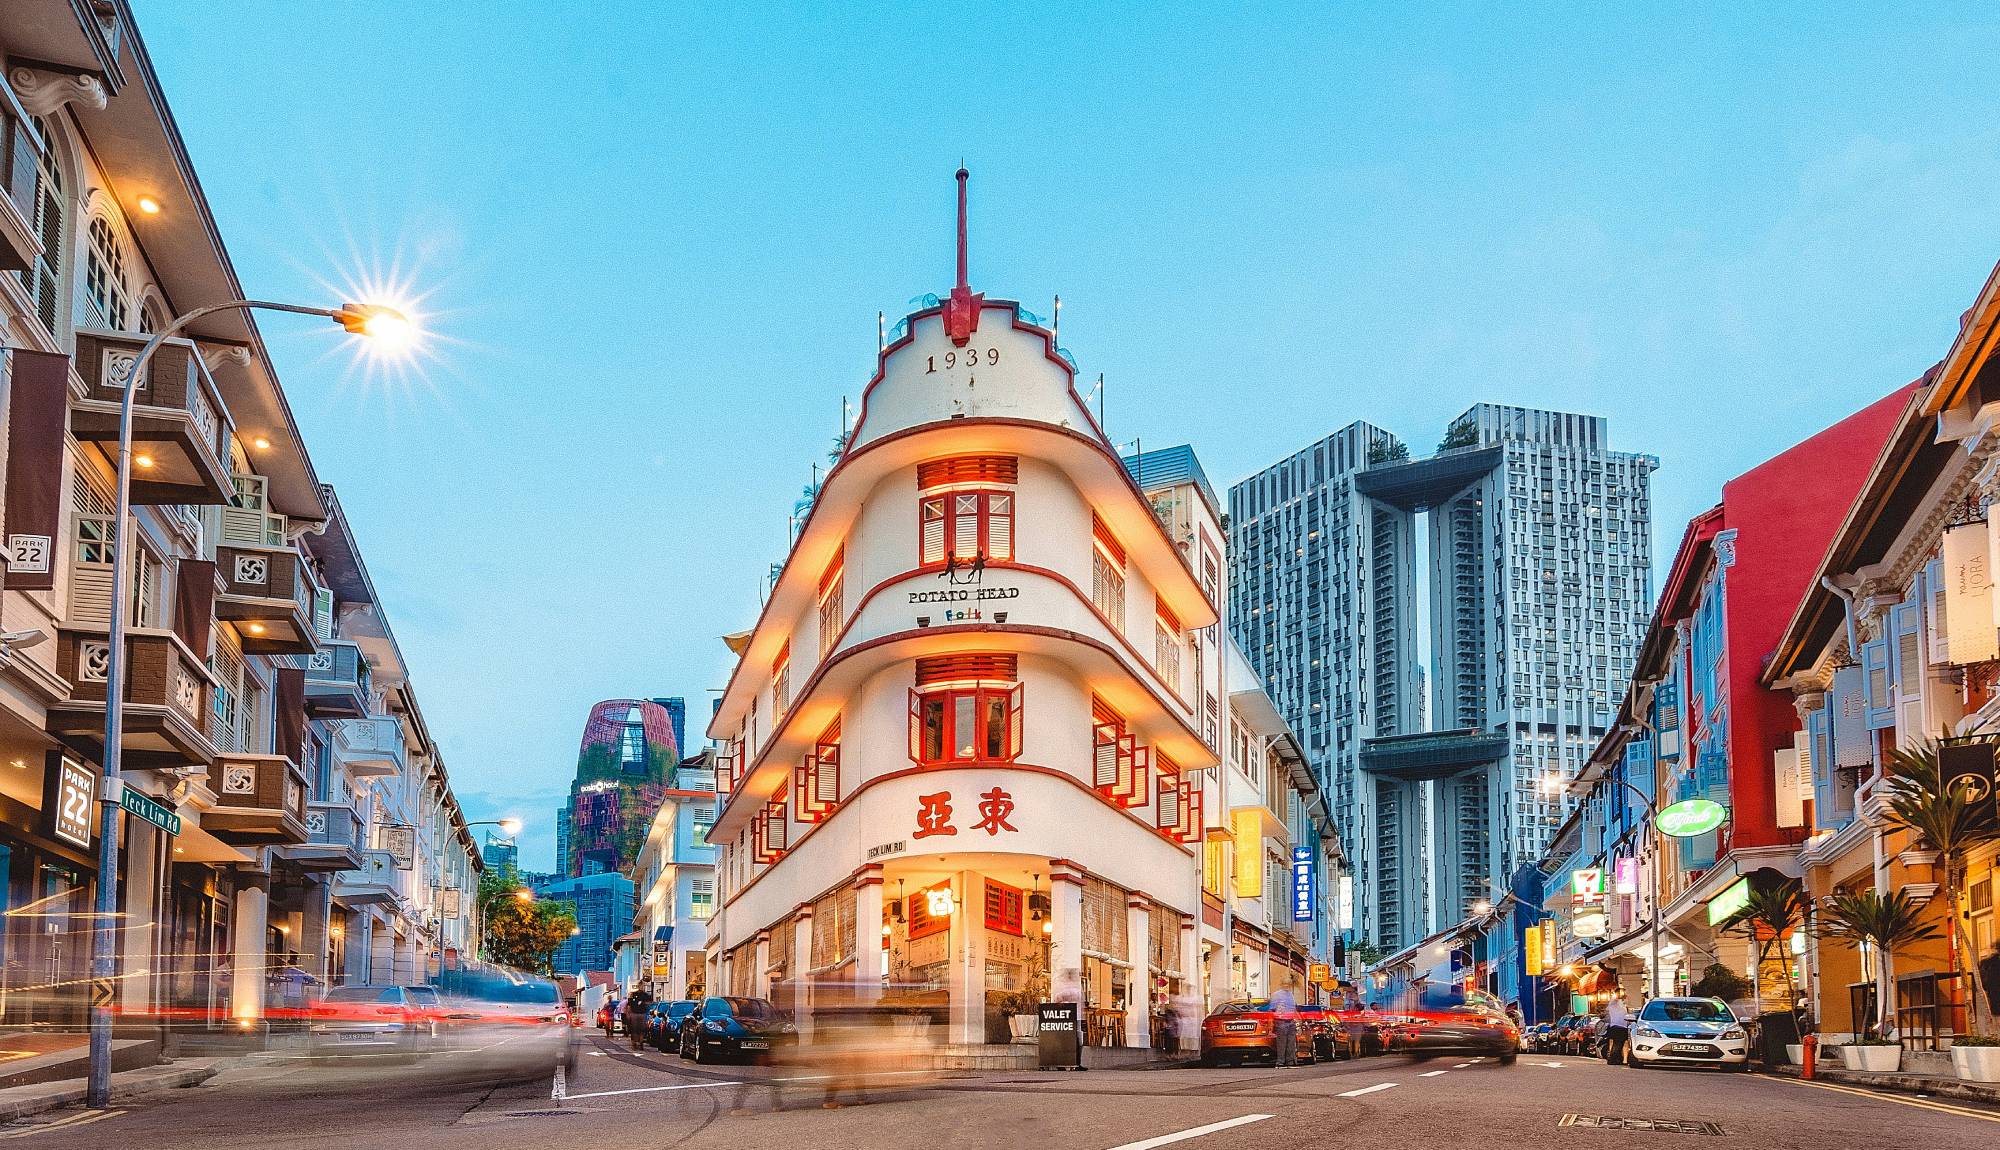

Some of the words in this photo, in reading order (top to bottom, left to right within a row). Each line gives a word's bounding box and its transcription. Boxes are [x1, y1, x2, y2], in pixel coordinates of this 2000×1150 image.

[925, 348, 999, 375] 1939
[17, 548, 41, 562] 22
[908, 589, 968, 603] POTATO
[976, 587, 1019, 600] HEAD
[945, 607, 981, 621] Folk
[65, 768, 90, 792] PARK
[63, 785, 88, 826] 22
[125, 790, 146, 816] Teck
[149, 807, 164, 826] Lim
[167, 815, 178, 832] Rd
[61, 819, 87, 838] hotel
[868, 845, 880, 859] TECK
[880, 843, 892, 855] LIM
[894, 841, 903, 852] RD
[1042, 1010, 1071, 1019] VALET
[1040, 1022, 1074, 1031] SERVICE
